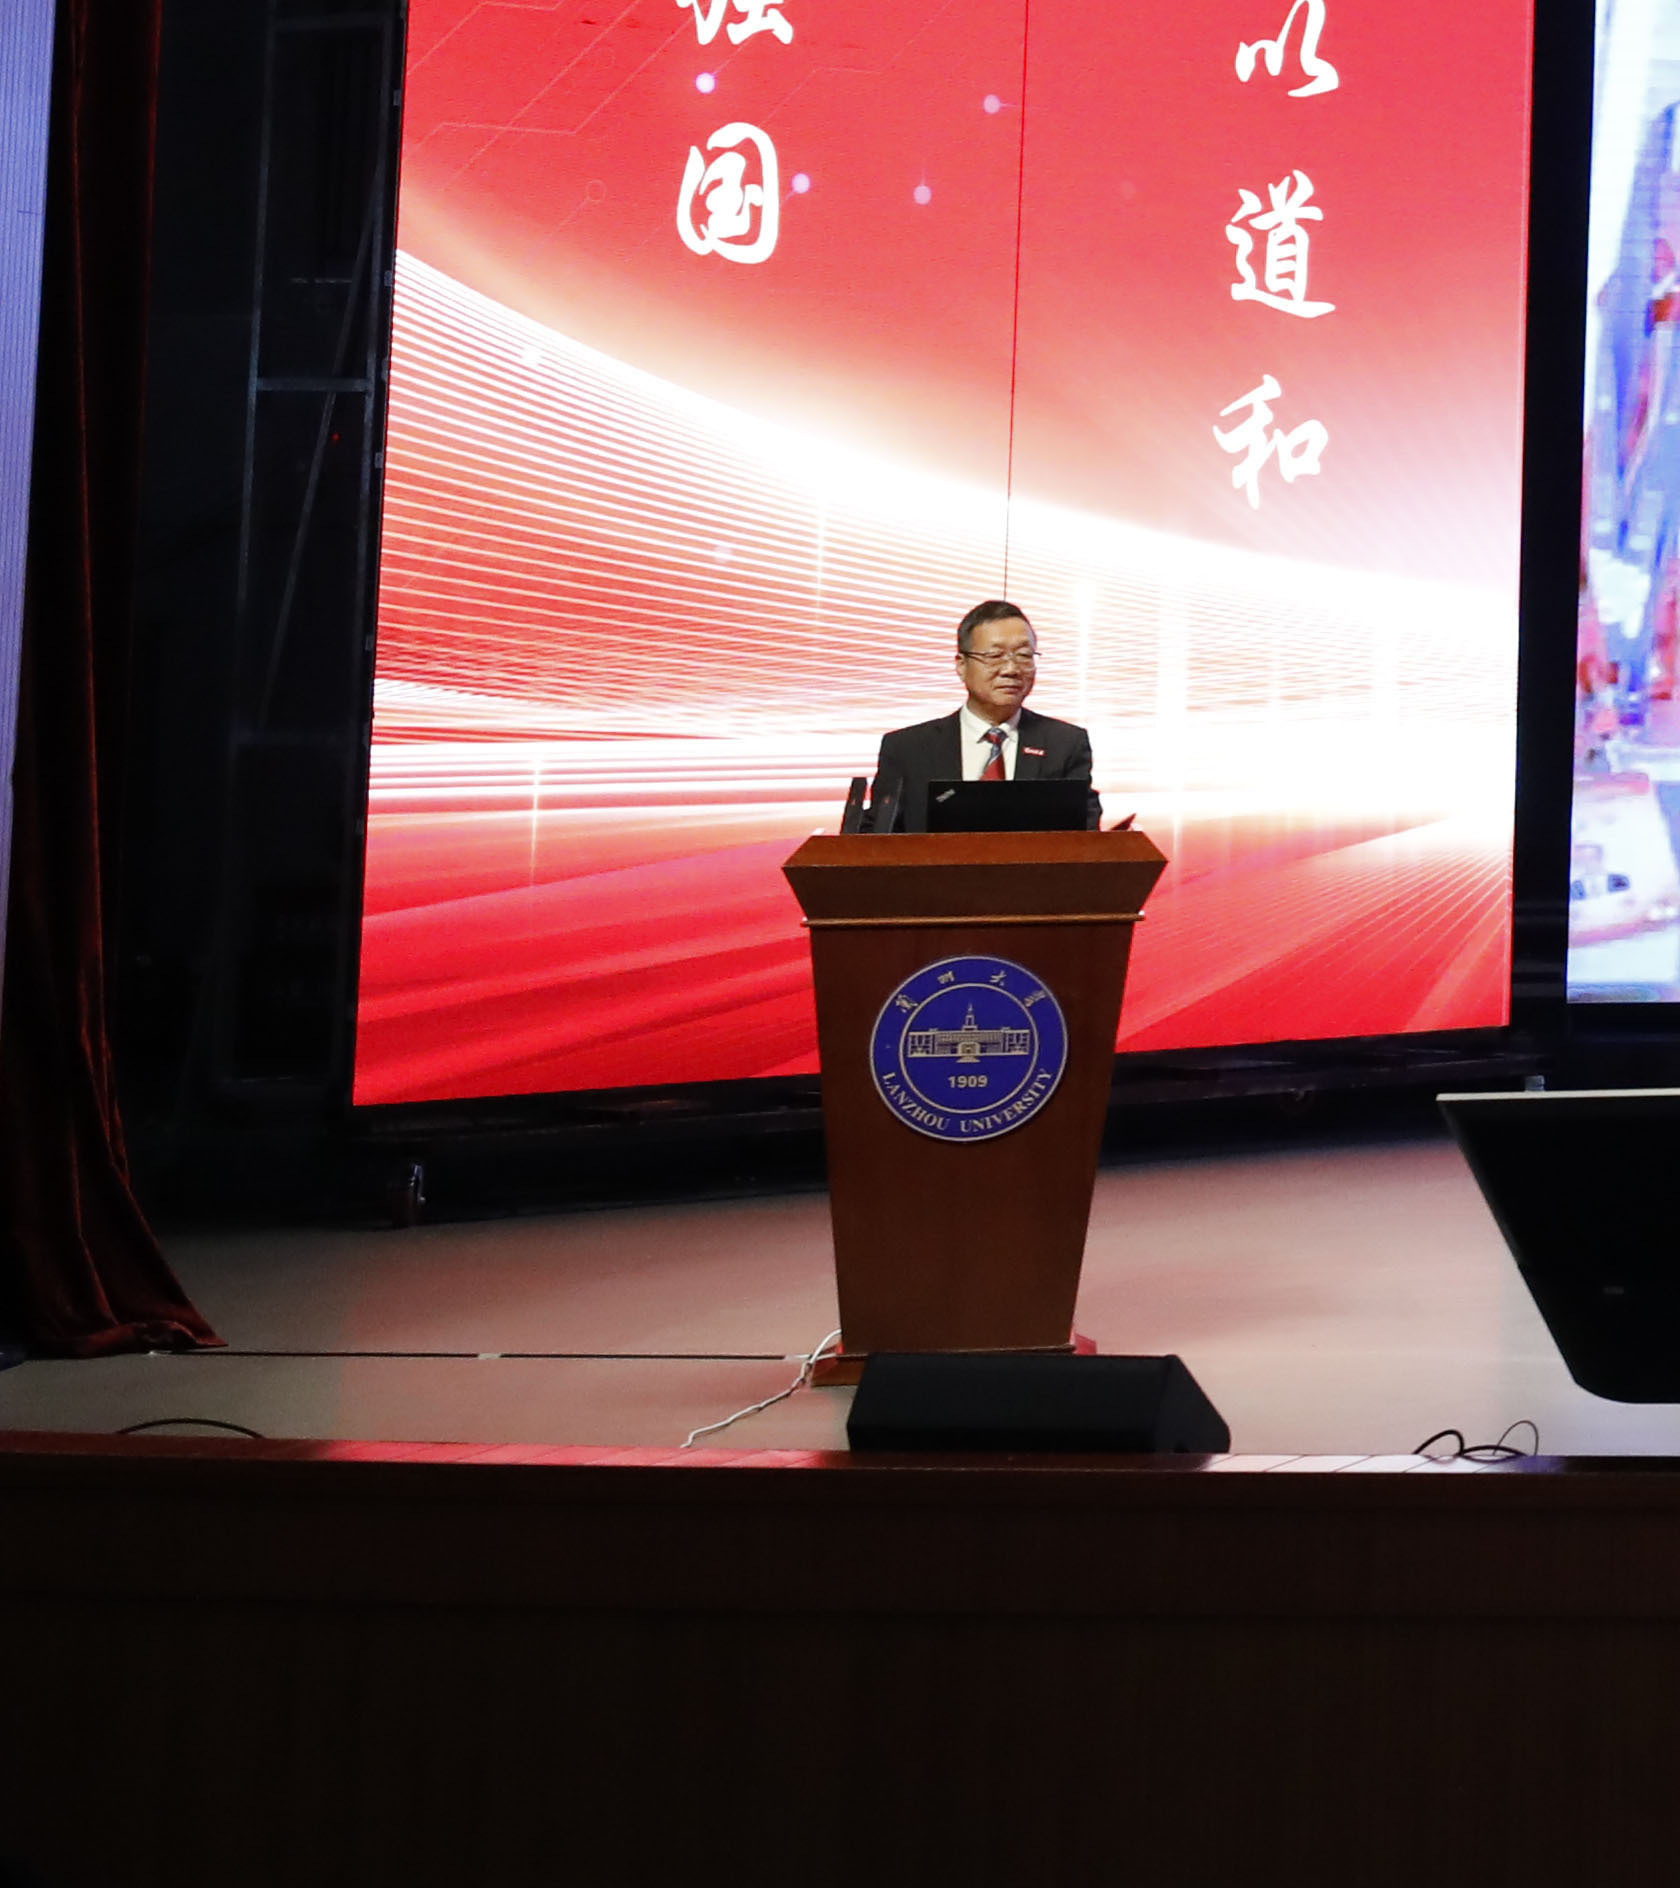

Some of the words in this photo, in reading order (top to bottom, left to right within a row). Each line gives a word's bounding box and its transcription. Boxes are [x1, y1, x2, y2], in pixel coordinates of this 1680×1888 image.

[882, 1071, 951, 1131] LANZHOU
[960, 1068, 1052, 1133] UNIVERSITY
[948, 1075, 989, 1089] 1909
